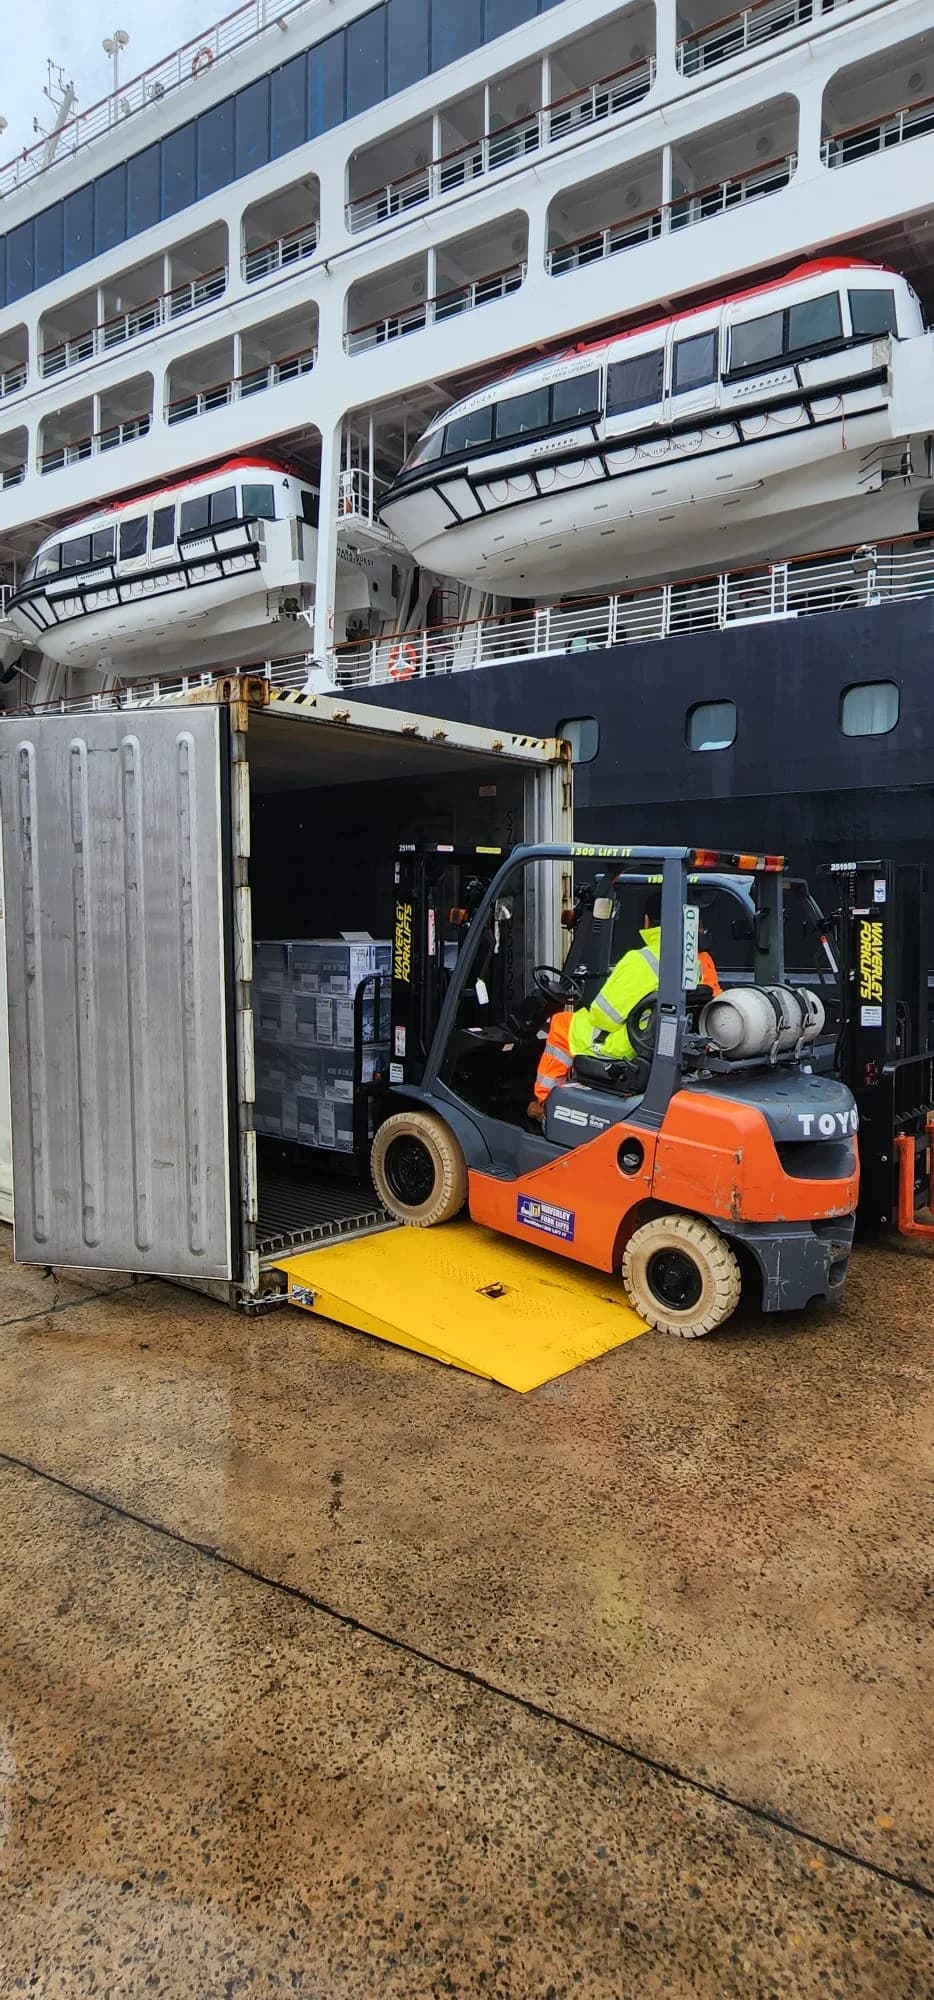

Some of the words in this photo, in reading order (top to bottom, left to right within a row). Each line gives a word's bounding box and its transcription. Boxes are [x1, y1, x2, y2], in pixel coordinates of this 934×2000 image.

[282, 478, 290, 490] 4
[598, 847, 618, 857] LIFT
[621, 848, 632, 858] IT
[647, 875, 664, 883] 130
[393, 899, 405, 980] WAVERLEY
[402, 902, 413, 984] FORKLIFTS
[860, 919, 873, 1001] FORKLIFTS
[871, 921, 884, 1003] WAVERLEY
[797, 1108, 859, 1136] TOYO
[541, 1203, 571, 1222] WAVERLEY
